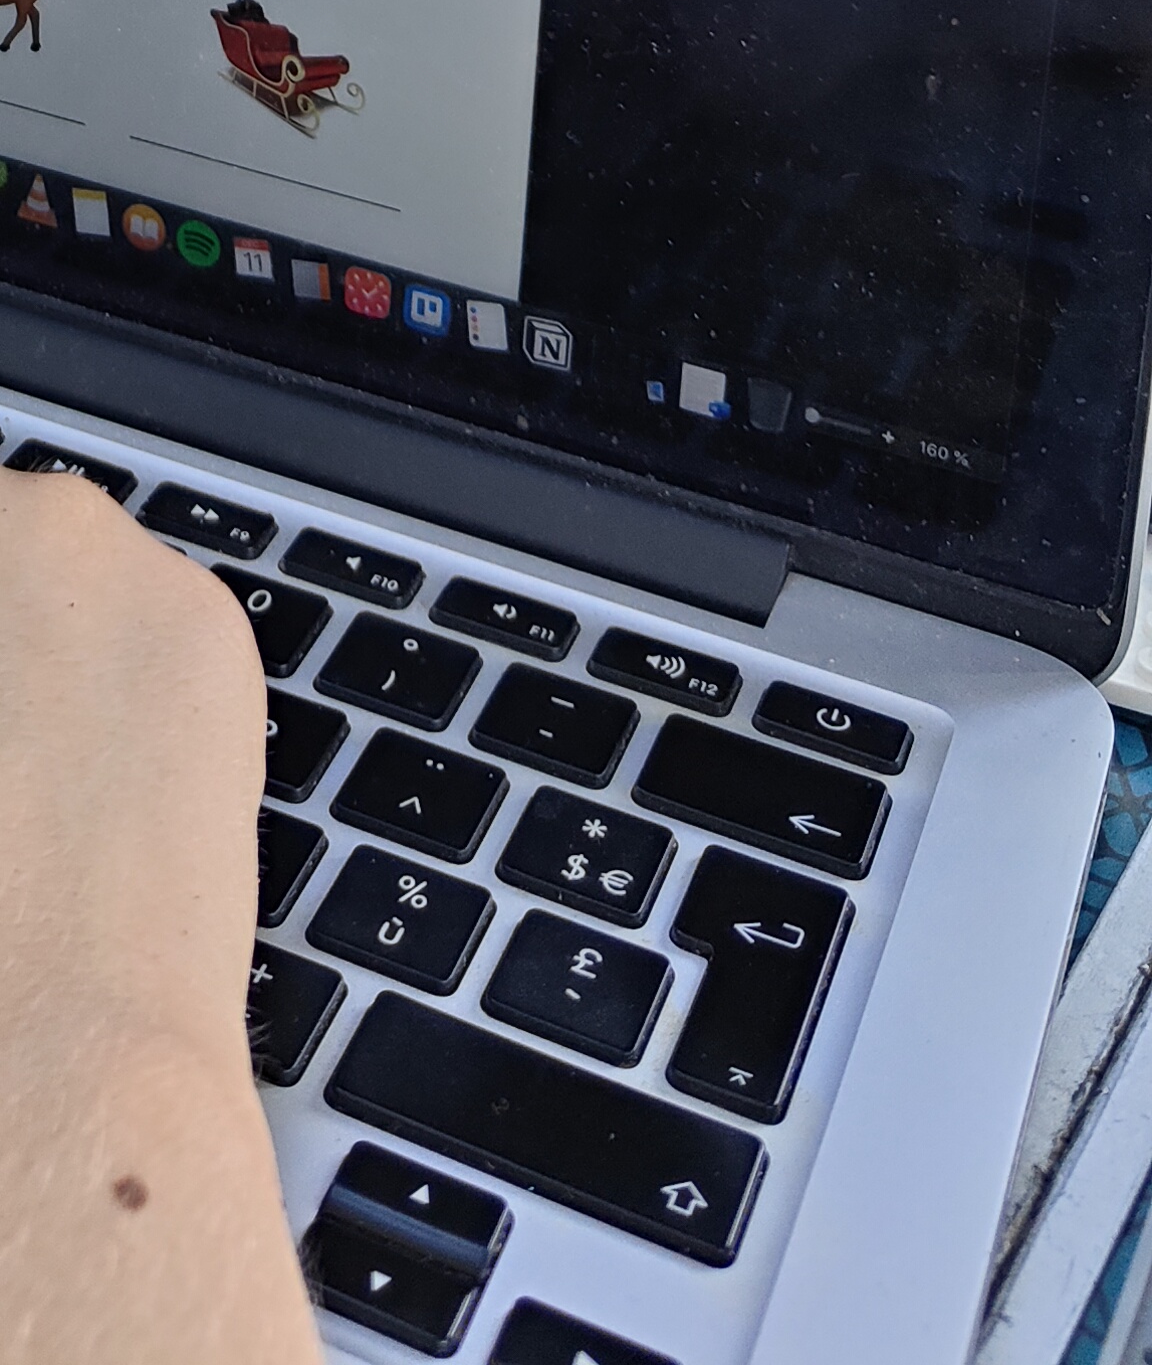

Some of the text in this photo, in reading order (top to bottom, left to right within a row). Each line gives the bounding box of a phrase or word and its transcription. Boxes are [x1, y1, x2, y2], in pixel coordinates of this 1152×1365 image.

[243, 252, 263, 272] 11
[920, 441, 950, 461] 160
[230, 527, 250, 541] F9
[370, 574, 398, 591] F10
[529, 625, 555, 642] F11
[689, 678, 719, 696] F12
[561, 854, 634, 896] $ €
[399, 875, 428, 909] %
[571, 948, 603, 979] £
